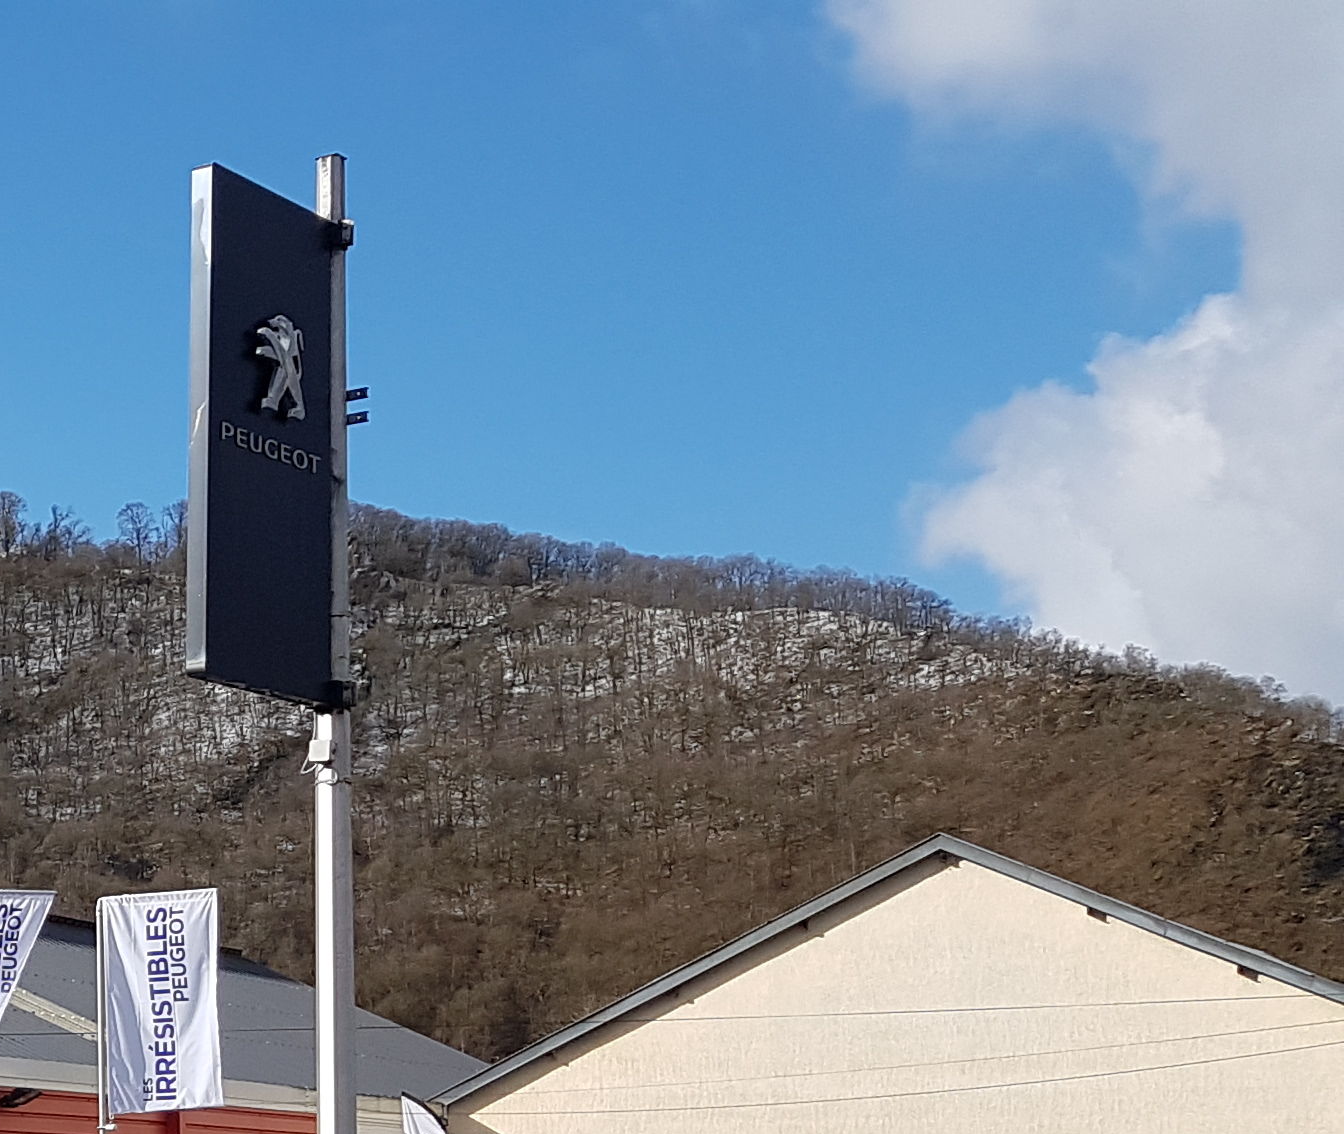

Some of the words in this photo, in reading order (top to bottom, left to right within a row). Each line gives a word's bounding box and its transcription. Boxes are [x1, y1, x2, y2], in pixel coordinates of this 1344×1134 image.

[221, 421, 322, 474] PEUGEOT
[169, 906, 190, 1002] PEUGEOT
[146, 907, 178, 1101] IRRÉSISTIBLES
[143, 1077, 154, 1102] LES
